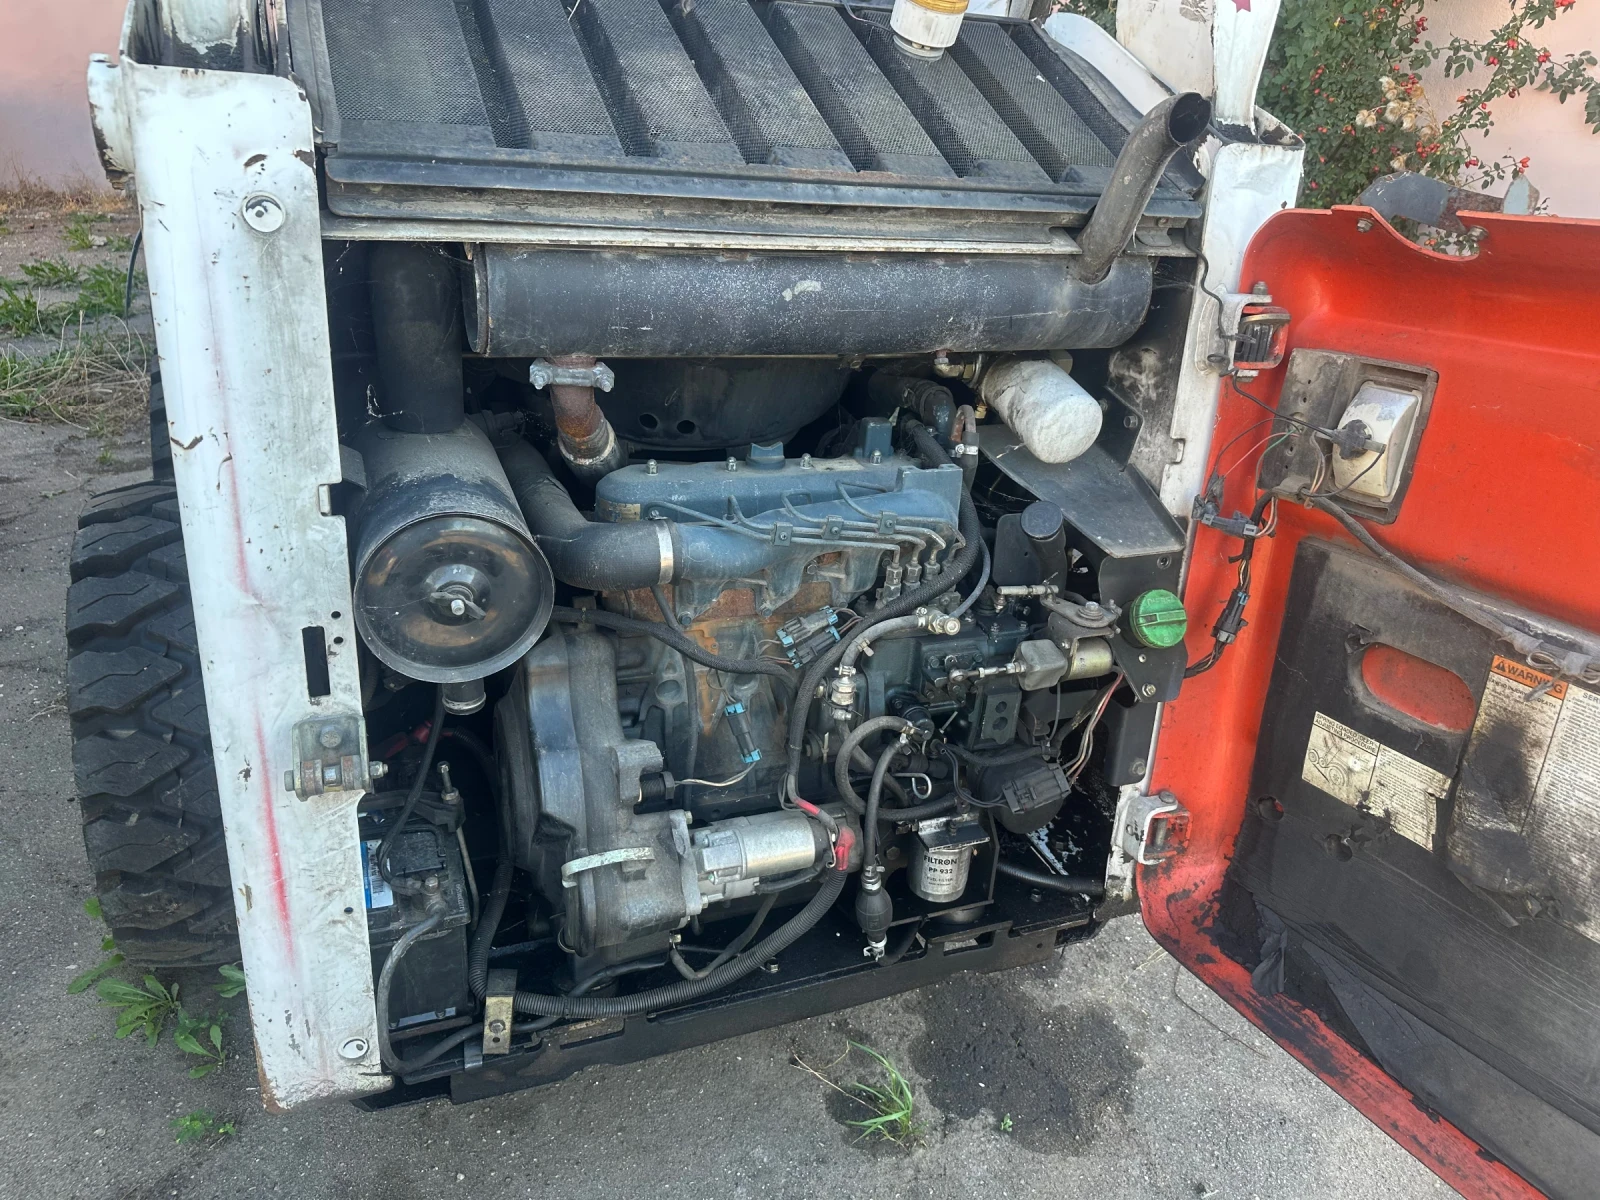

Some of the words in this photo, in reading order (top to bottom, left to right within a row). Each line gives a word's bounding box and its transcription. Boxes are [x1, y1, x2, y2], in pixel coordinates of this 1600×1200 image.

[1507, 665, 1562, 693] WARNG
[1315, 718, 1343, 736] ADJUSTING
[1343, 733, 1376, 752] PROCEDURE
[1316, 713, 1336, 726] SPRING
[1335, 723, 1357, 737] LOADED
[924, 855, 958, 865] FILTRON
